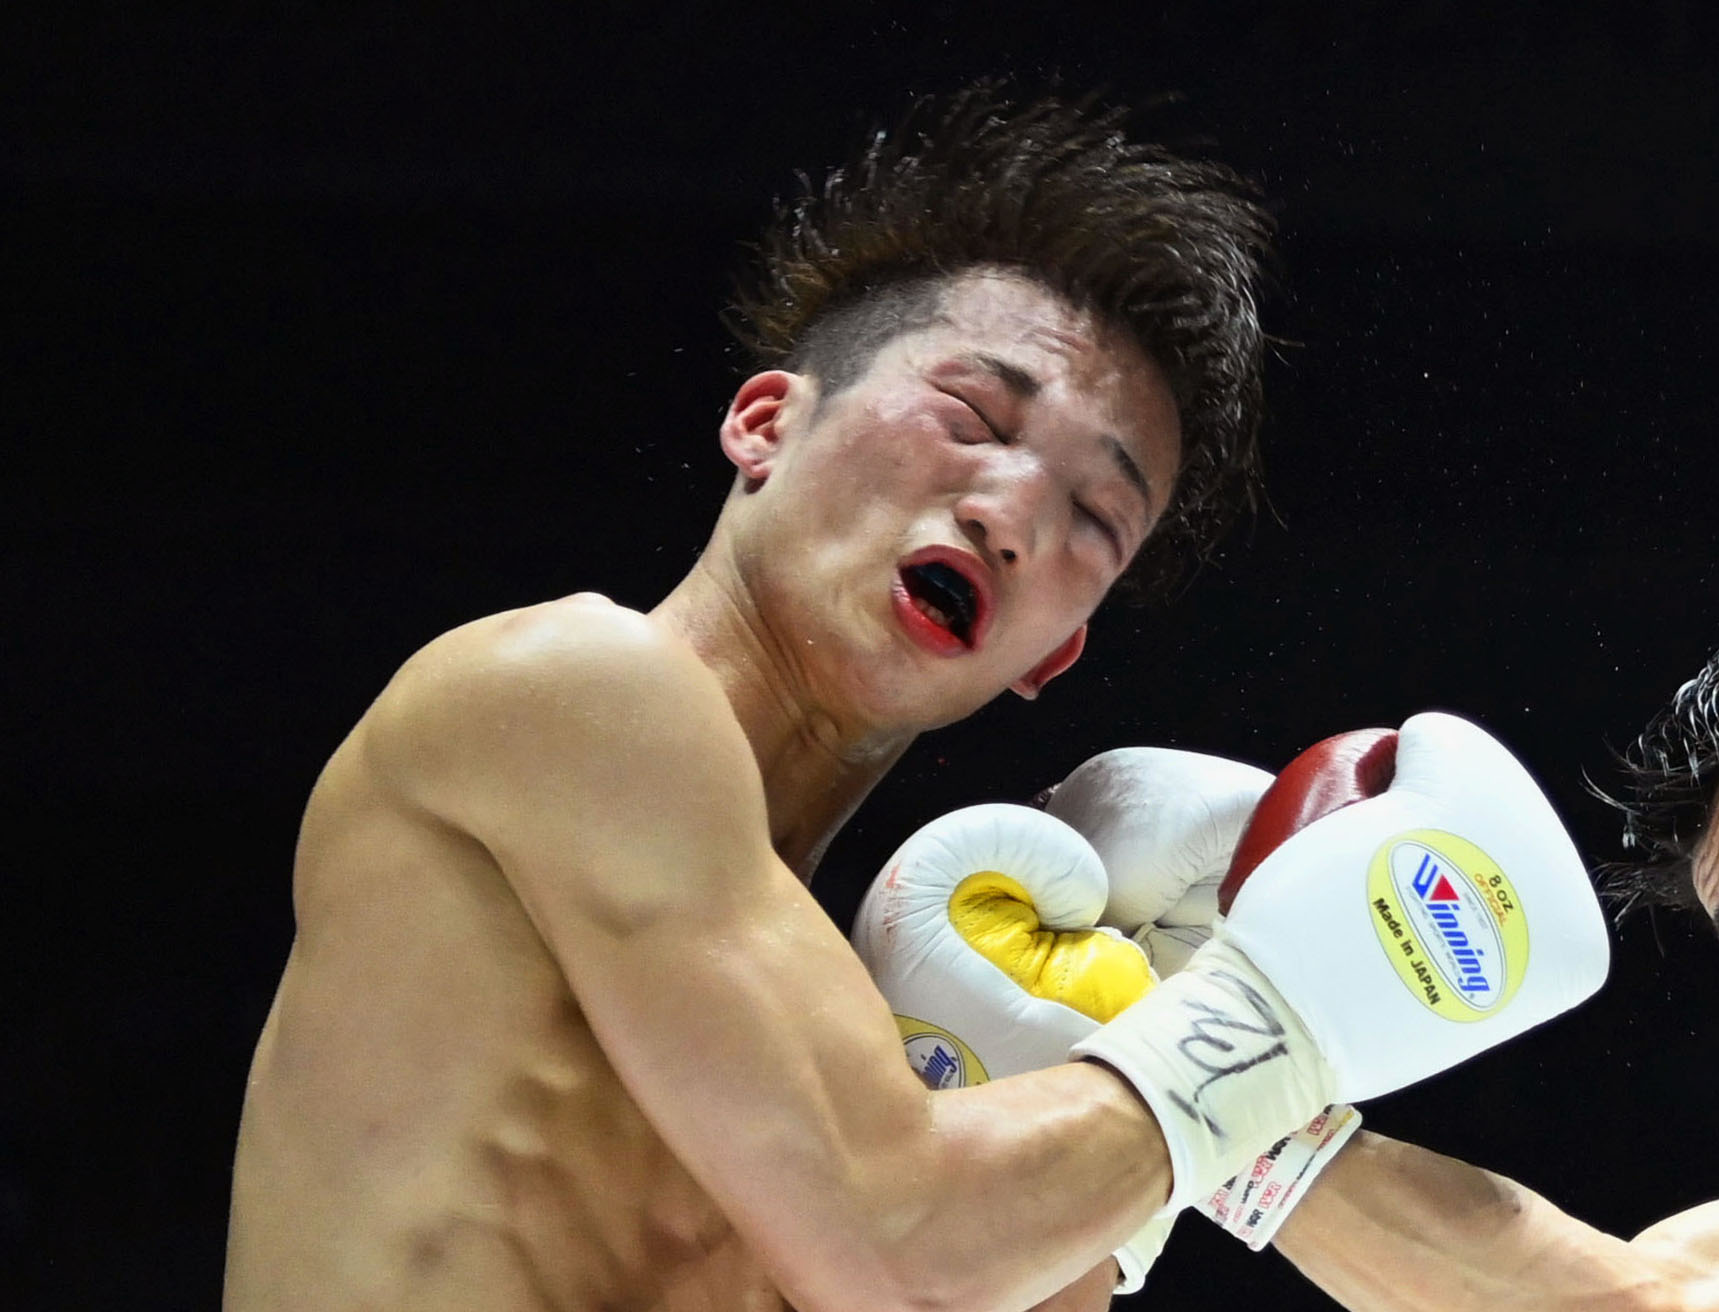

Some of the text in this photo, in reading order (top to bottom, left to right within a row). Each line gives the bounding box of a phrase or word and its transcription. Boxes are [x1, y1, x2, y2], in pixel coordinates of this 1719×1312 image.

[1474, 873, 1507, 928] OFFICIAL
[1489, 874, 1502, 889] 8
[1373, 898, 1441, 1005] Made in JAPAN
[1411, 853, 1491, 992] Winning
